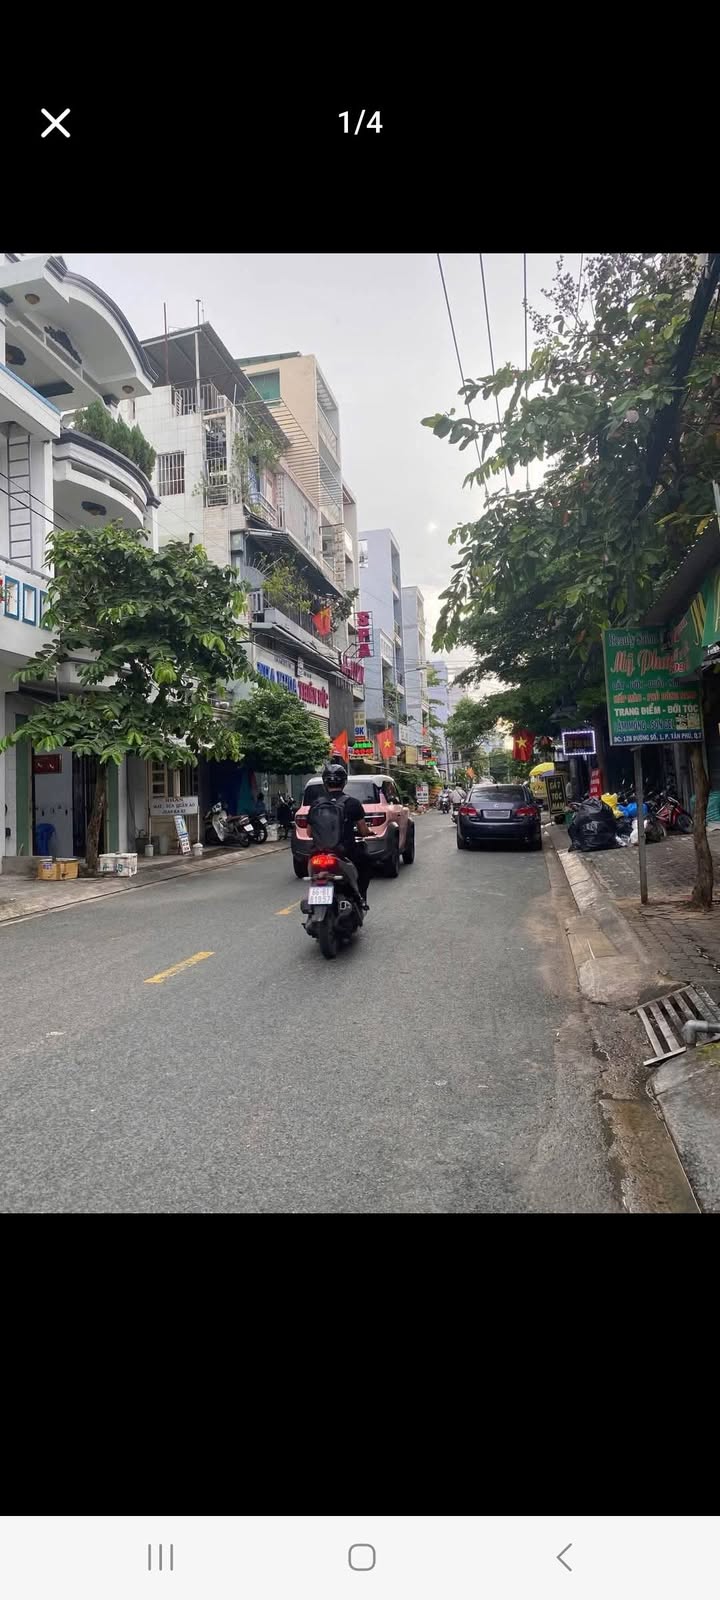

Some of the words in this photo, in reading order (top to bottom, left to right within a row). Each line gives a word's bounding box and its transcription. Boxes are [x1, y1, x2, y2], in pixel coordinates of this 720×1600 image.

[357, 611, 370, 658] SPA
[614, 706, 640, 717] TRANG
[641, 703, 661, 716] ĐIỂM
[354, 726, 364, 736] 9K
